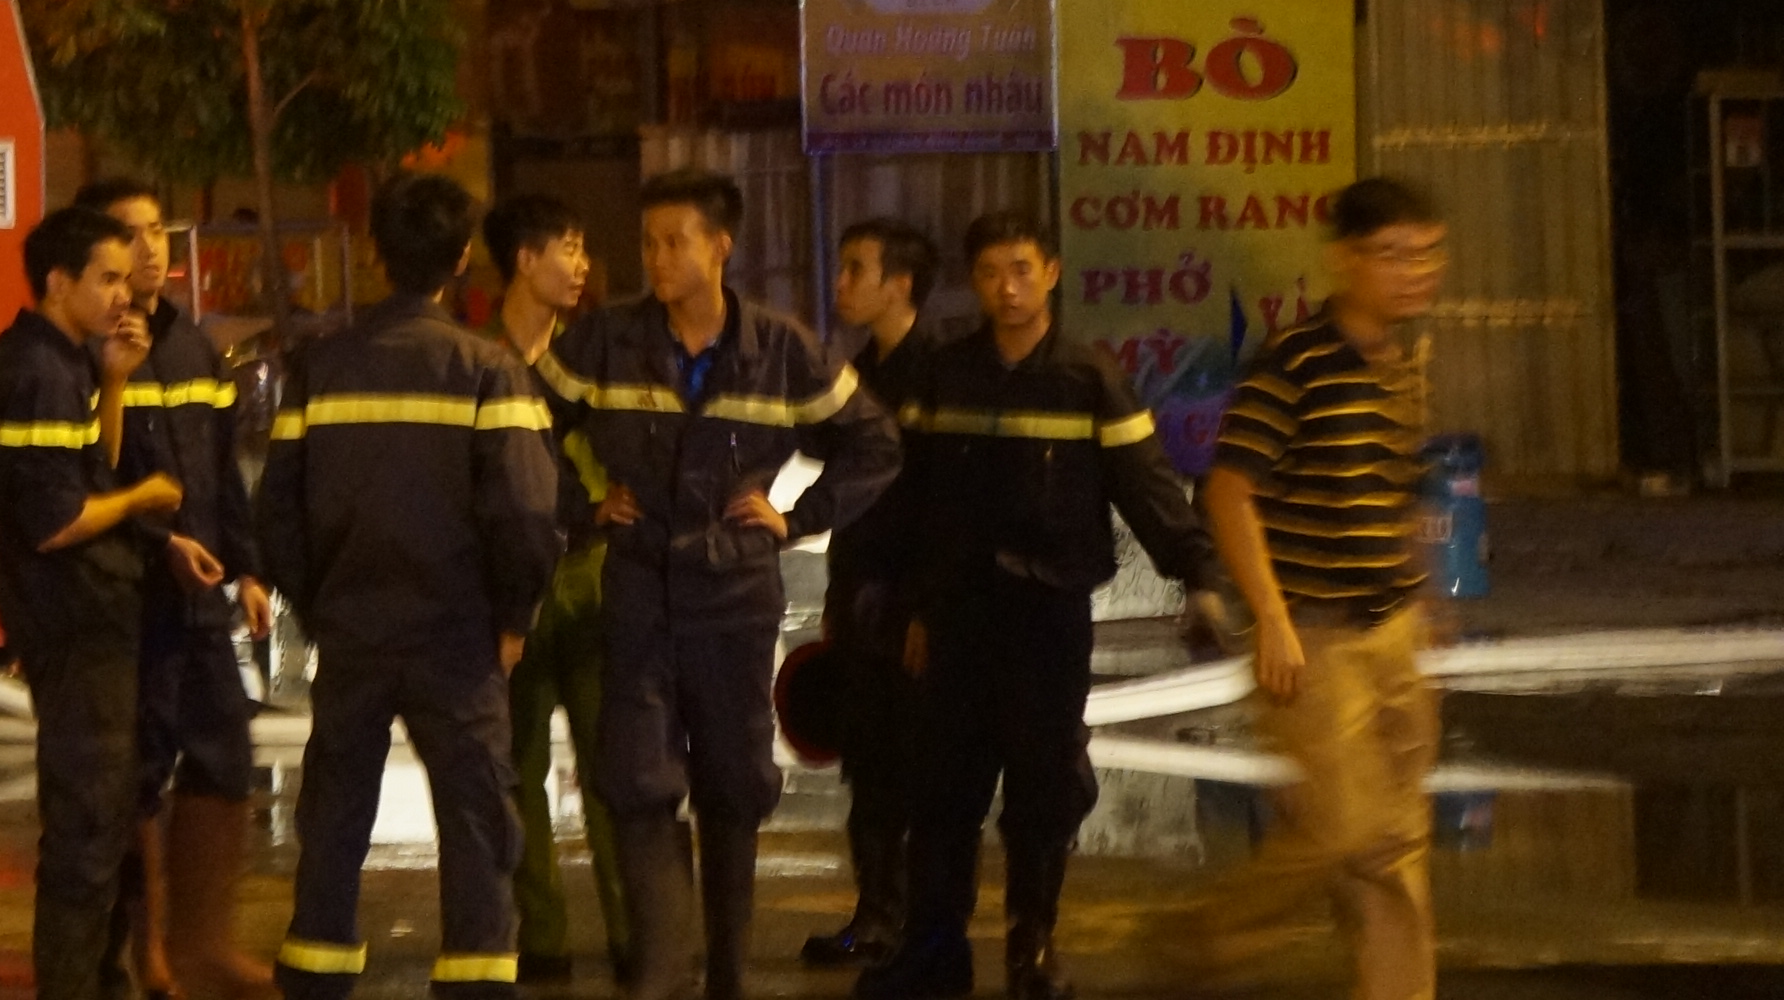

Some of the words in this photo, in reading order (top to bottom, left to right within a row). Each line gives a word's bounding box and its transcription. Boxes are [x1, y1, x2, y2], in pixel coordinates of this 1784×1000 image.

[1115, 16, 1298, 102] BÒ
[884, 65, 954, 116] món
[1077, 129, 1192, 166] NAM
[1205, 128, 1332, 175] ĐỊNH
[1069, 188, 1181, 231] CƠM
[1081, 249, 1213, 305] PHỞ
